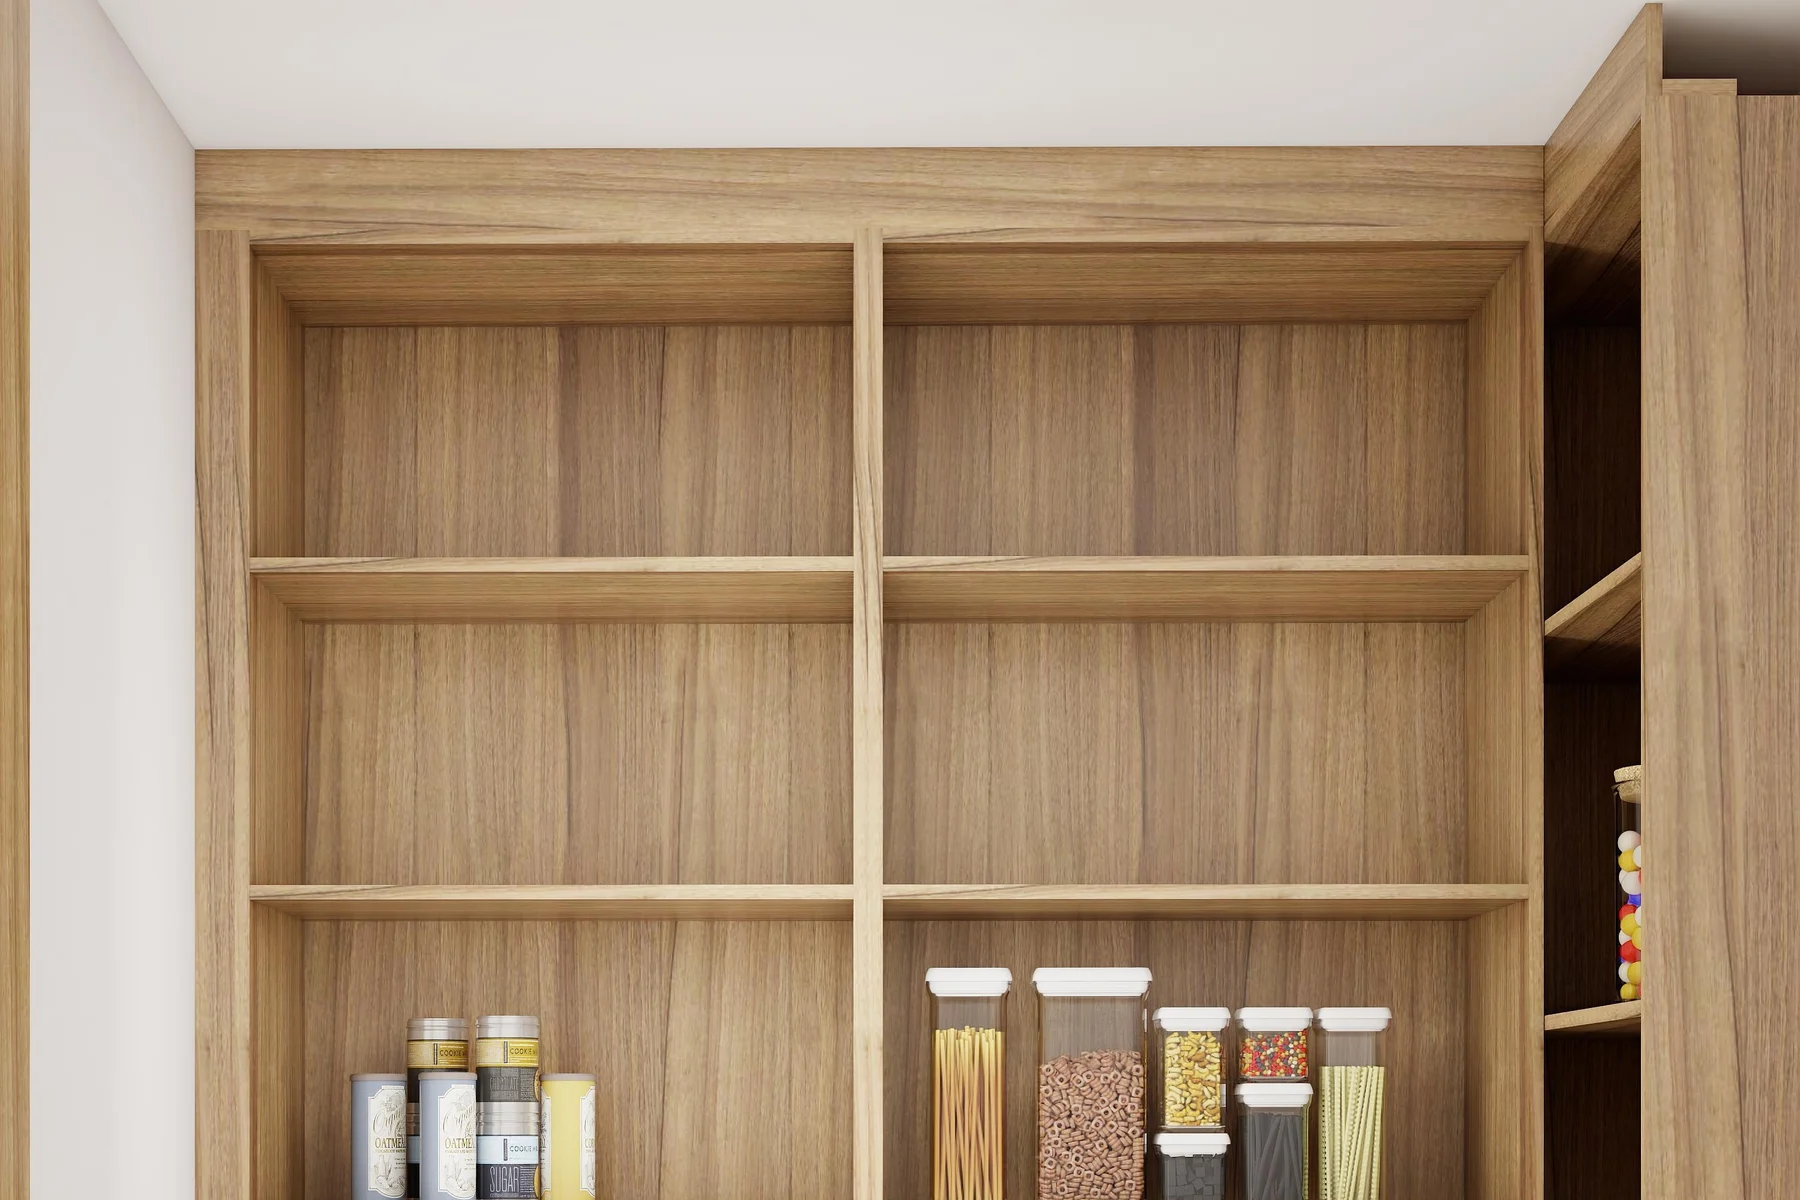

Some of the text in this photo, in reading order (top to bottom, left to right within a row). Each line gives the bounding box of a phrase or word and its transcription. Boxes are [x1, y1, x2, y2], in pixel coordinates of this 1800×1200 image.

[439, 1049, 462, 1057] COOKIE
[510, 1047, 532, 1055] COOKIE
[489, 1165, 520, 1193] SUGAR
